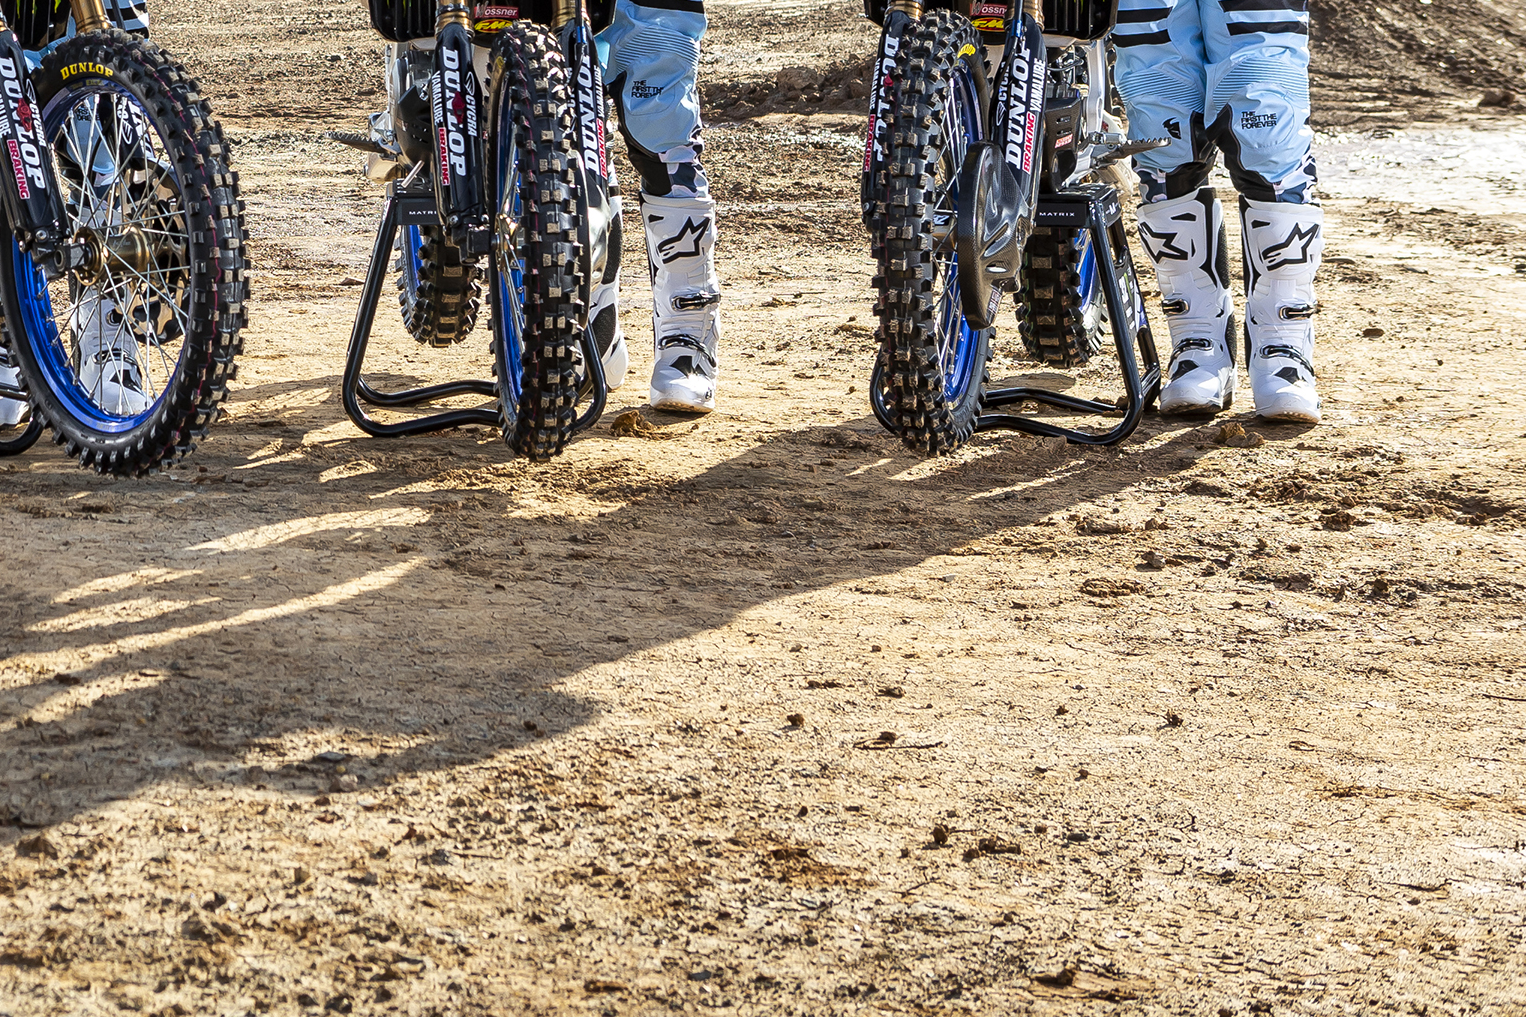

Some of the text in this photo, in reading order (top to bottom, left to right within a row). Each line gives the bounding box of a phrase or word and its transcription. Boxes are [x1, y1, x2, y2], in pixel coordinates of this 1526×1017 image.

[475, 0, 518, 18] Wossner
[59, 61, 115, 80] DUNLOP
[1029, 56, 1047, 113] YAMALUBE
[430, 70, 445, 126] YAMALUBE
[464, 98, 478, 138] CYCRA
[1241, 110, 1256, 118] THE
[28, 102, 48, 148] CYCRA
[595, 117, 608, 181] BRAKING
[1021, 110, 1037, 177] BRAKING
[1241, 120, 1278, 131] FOREVER
[6, 138, 31, 200] BRAKING
[437, 125, 451, 187] BRAKING
